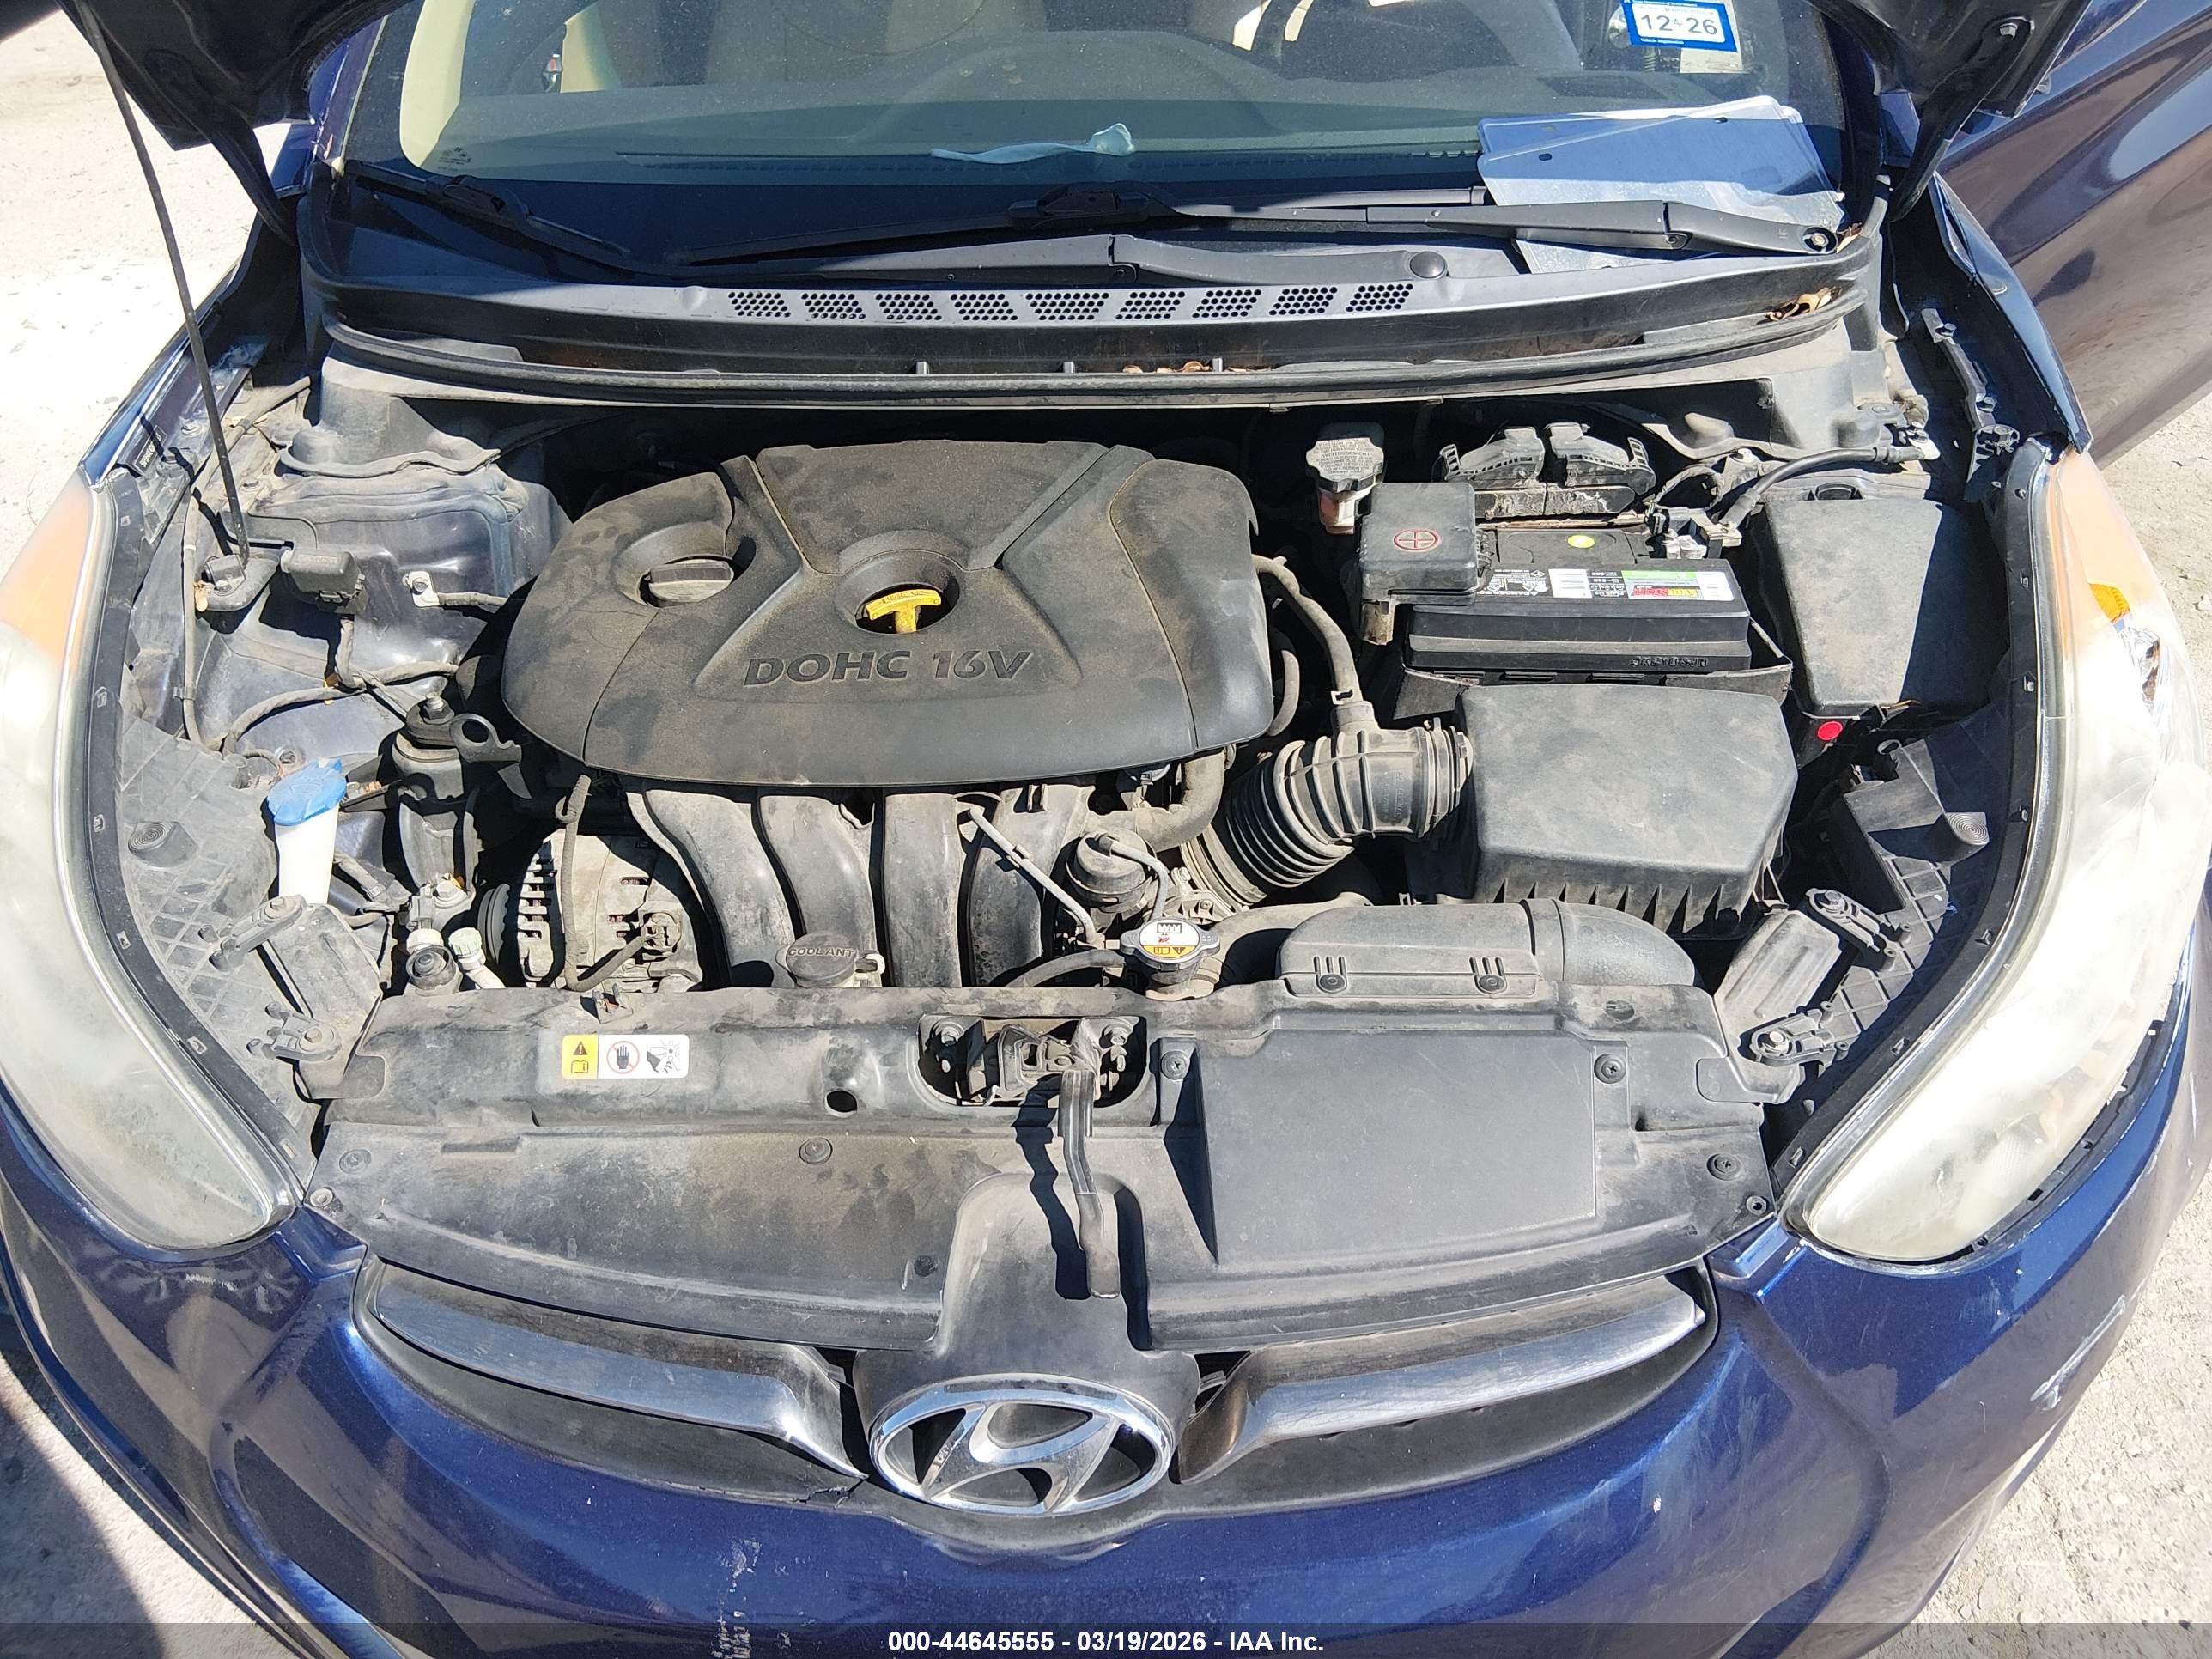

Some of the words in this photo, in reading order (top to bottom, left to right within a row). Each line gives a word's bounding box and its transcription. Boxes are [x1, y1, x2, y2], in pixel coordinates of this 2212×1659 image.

[1640, 14, 1674, 32] 12
[1685, 17, 1718, 35] 26
[743, 650, 911, 687] DOHC
[933, 650, 1032, 680] 16V
[788, 947, 855, 957] COOLANT
